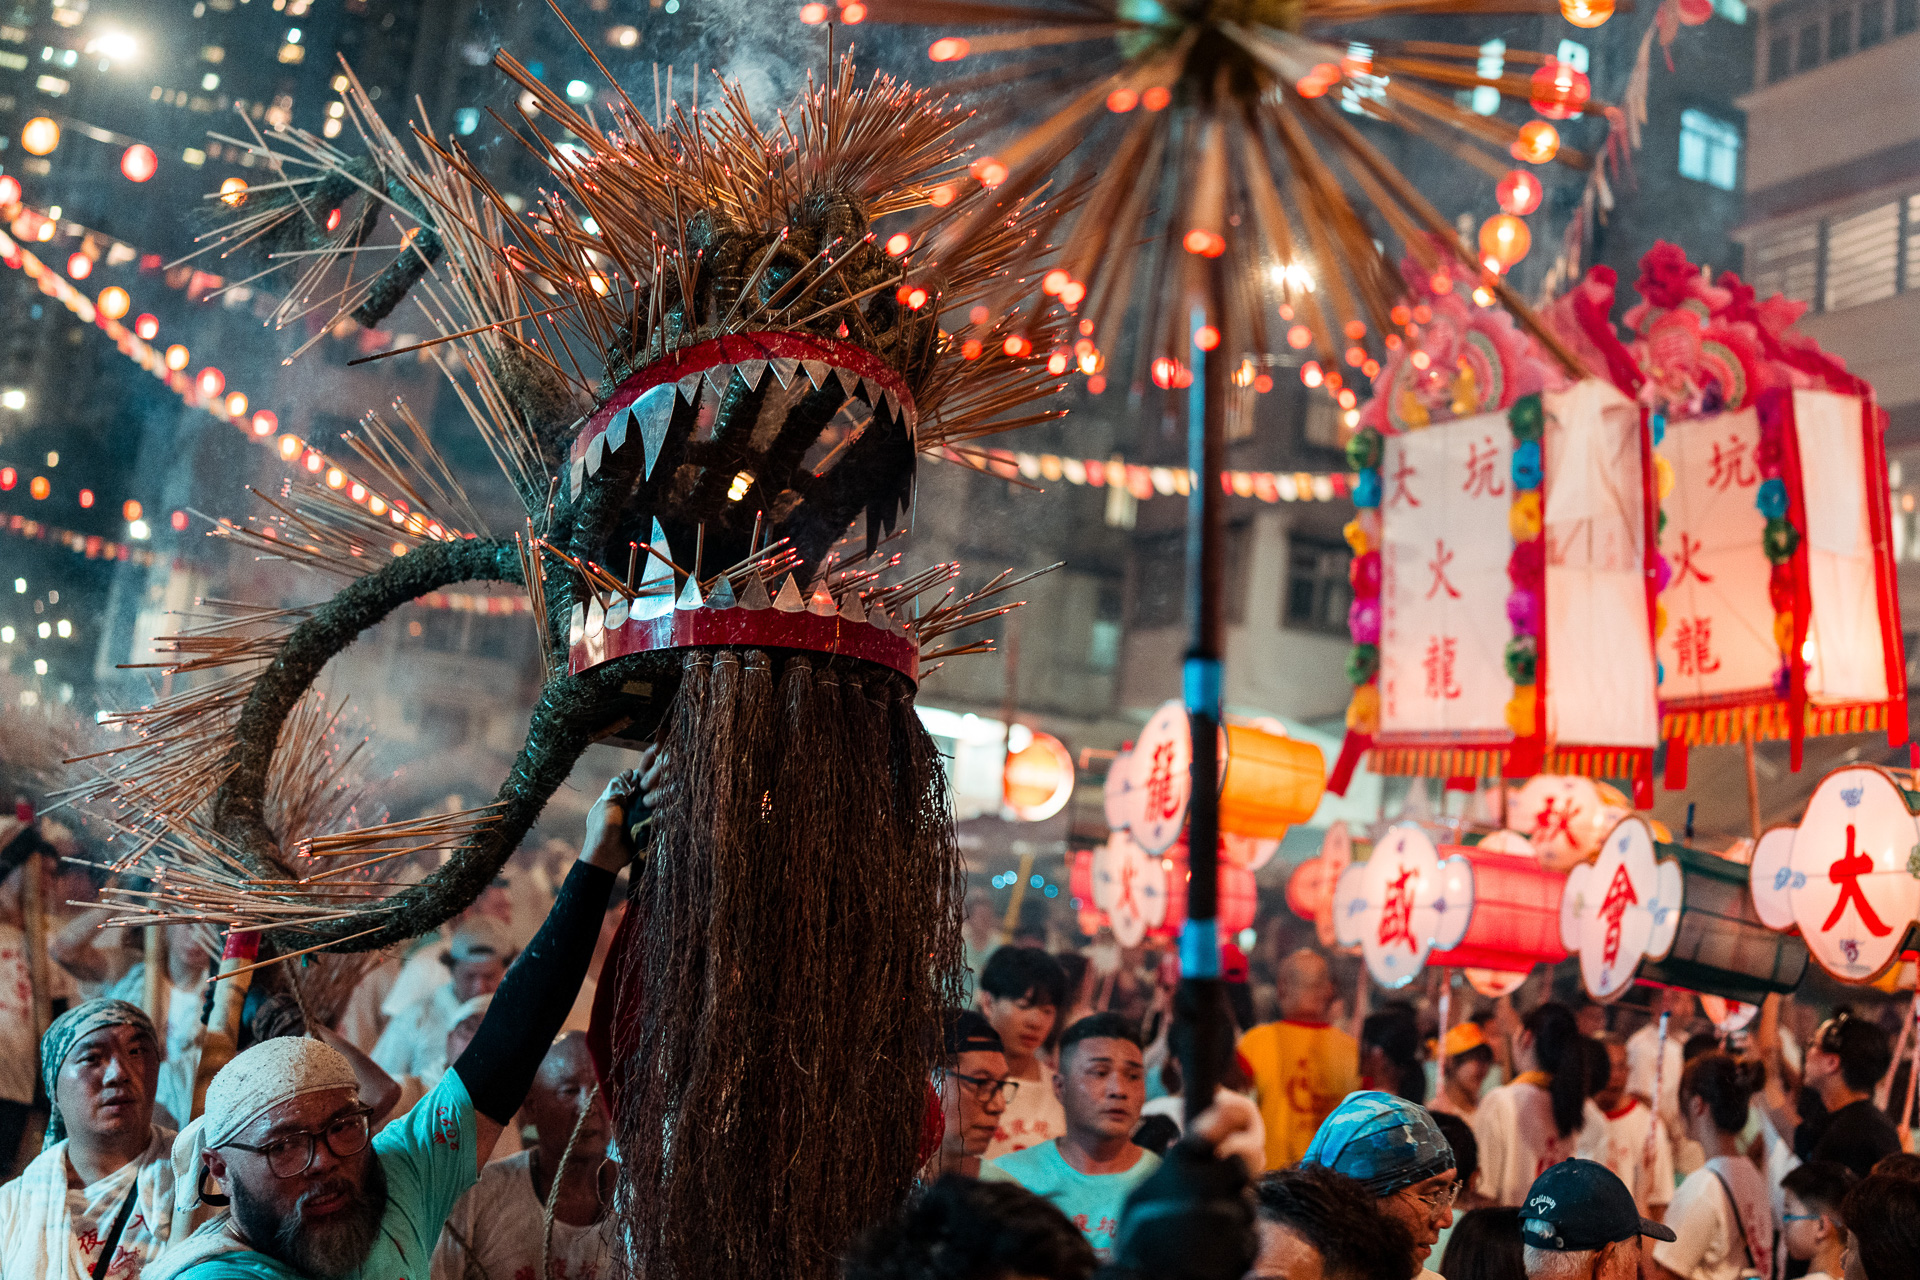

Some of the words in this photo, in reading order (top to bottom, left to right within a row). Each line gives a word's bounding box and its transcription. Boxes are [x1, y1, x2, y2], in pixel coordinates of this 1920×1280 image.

[1707, 434, 1757, 492] 坑
[1529, 796, 1582, 850] 秋
[1597, 861, 1639, 969] 會
[1821, 824, 1894, 937] 大
